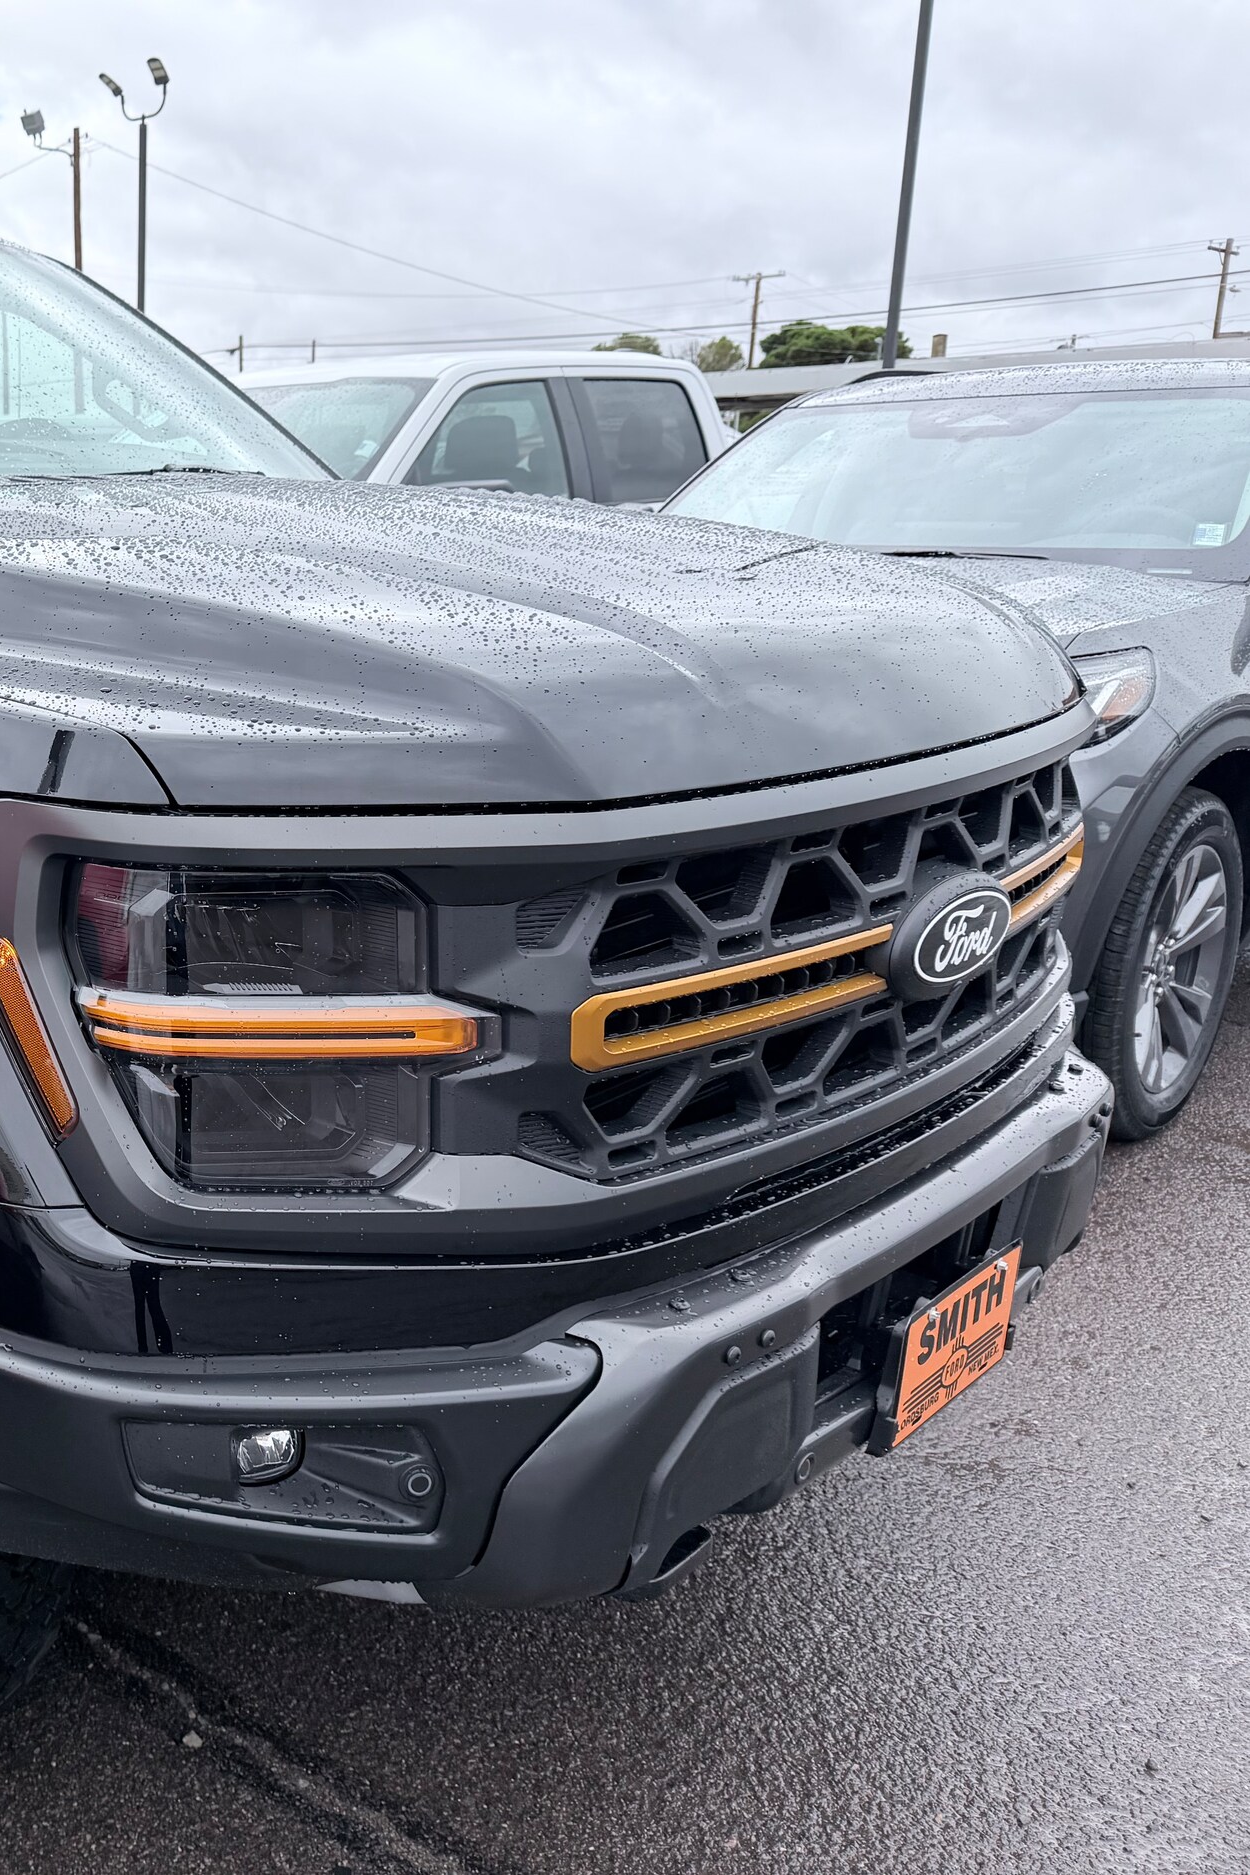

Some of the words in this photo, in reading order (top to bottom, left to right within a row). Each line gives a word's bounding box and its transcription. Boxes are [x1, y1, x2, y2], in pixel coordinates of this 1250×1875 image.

[935, 905, 997, 972] Ford
[918, 1269, 1006, 1365] SMITH
[945, 1355, 964, 1381] FORD
[968, 1357, 983, 1375] NEW
